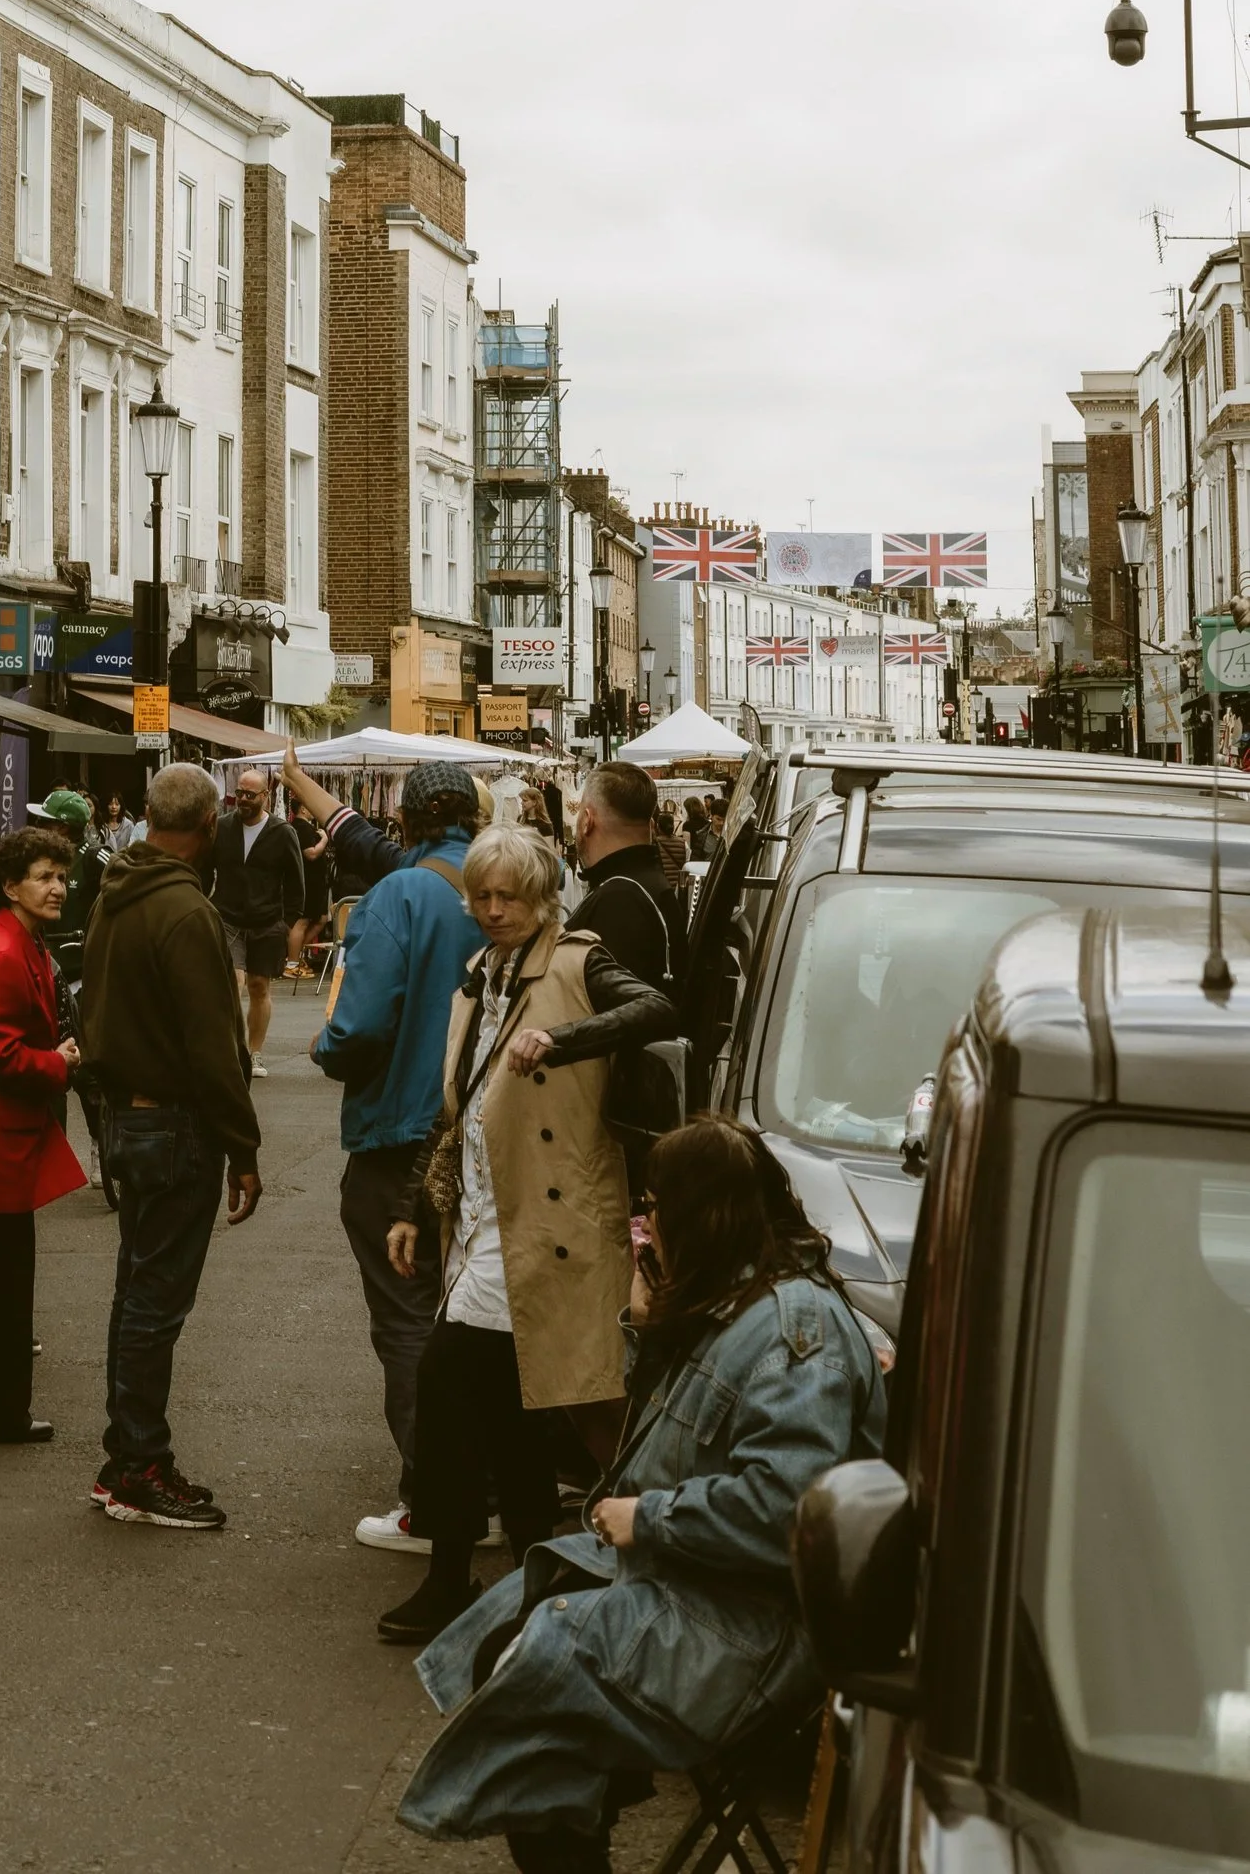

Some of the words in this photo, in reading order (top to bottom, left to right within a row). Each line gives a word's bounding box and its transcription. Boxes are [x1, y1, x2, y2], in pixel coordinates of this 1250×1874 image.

[61, 623, 108, 638] cannacy
[501, 640, 555, 652] TESCO
[500, 657, 555, 673] express
[336, 667, 358, 675] ALBA
[485, 703, 523, 711] PASSPORT
[485, 731, 524, 741] PHOTOS
